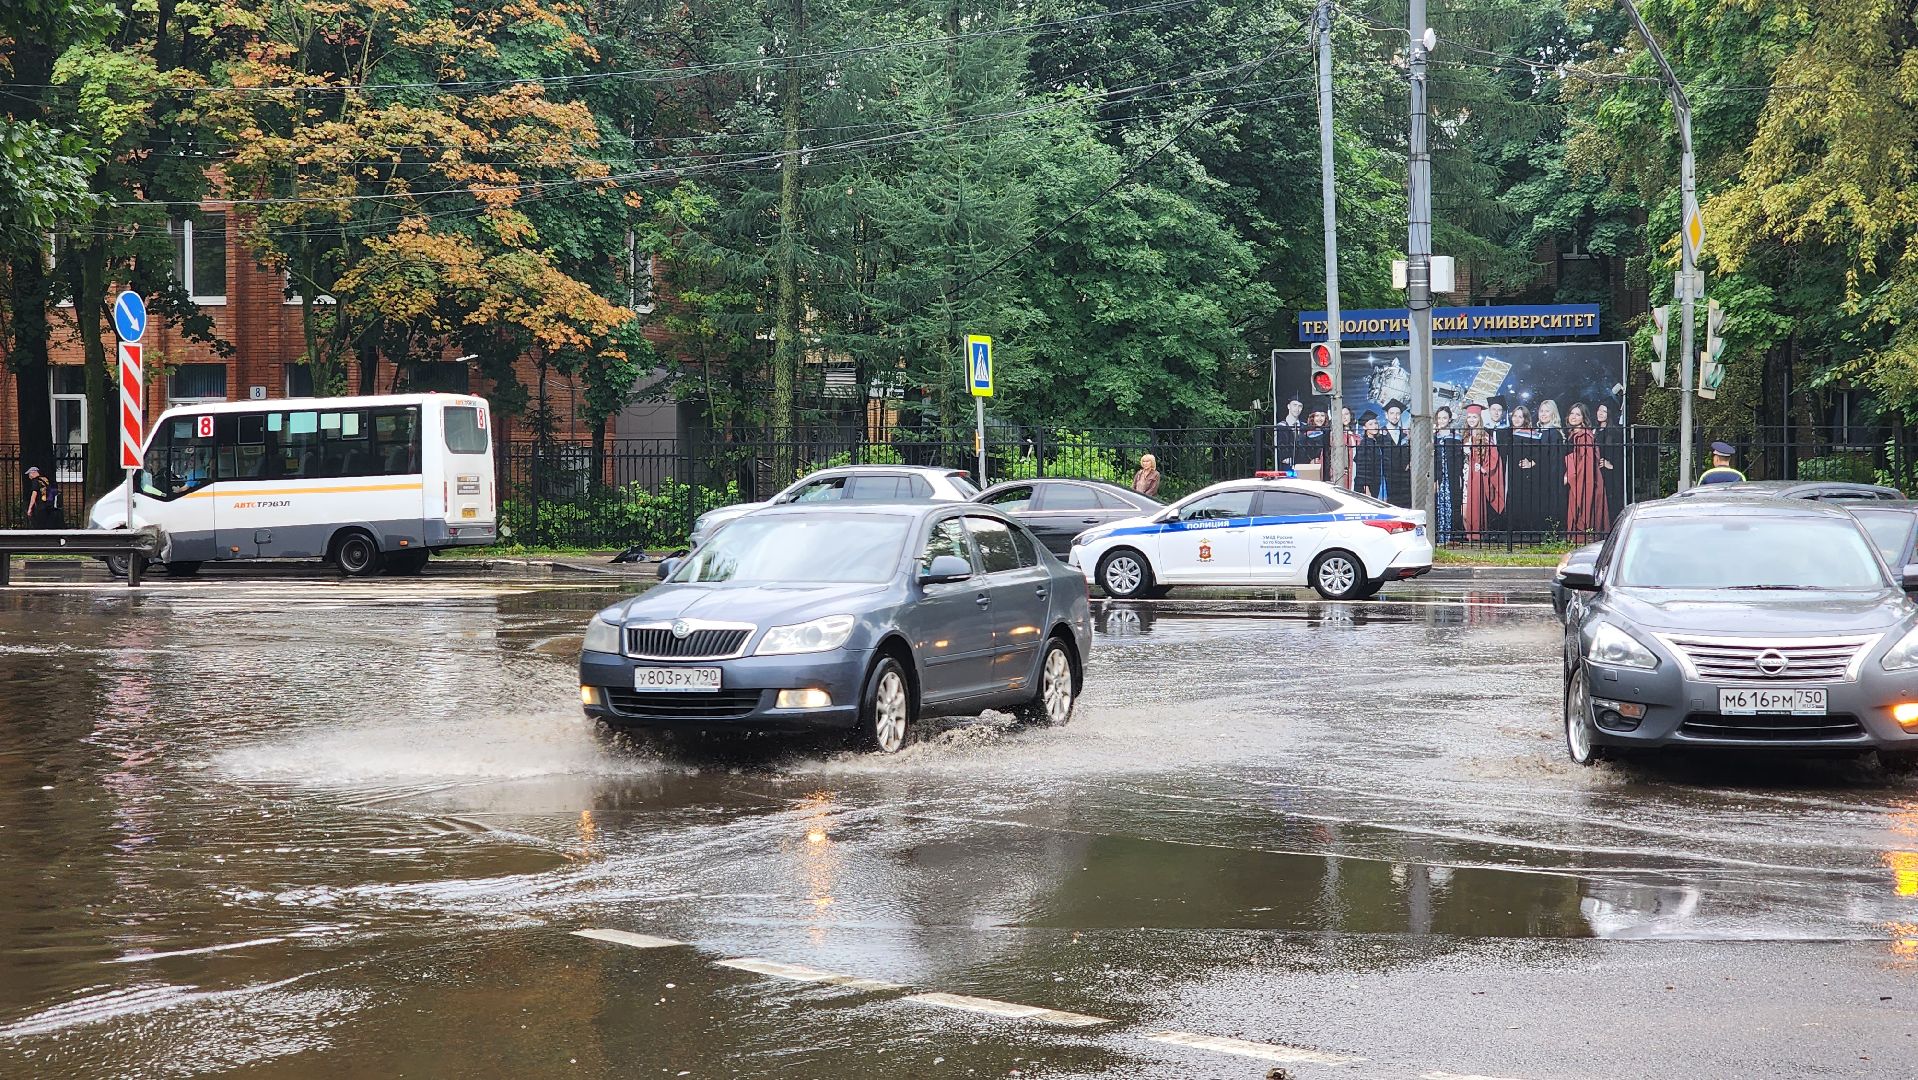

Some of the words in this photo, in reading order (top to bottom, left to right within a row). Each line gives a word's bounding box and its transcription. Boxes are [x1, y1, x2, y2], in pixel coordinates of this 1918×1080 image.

[1472, 313, 1596, 330] УНИВЕРСИТЕТ
[255, 387, 261, 398] 8
[200, 417, 211, 436] 8
[478, 409, 484, 428] 8
[1186, 520, 1230, 530] ПОЛИЦИЯ
[1264, 551, 1292, 565] 112
[639, 670, 692, 686] У803РХ
[695, 669, 717, 681] 790
[1725, 691, 1793, 708] М616РМ
[1796, 690, 1822, 704] 750
